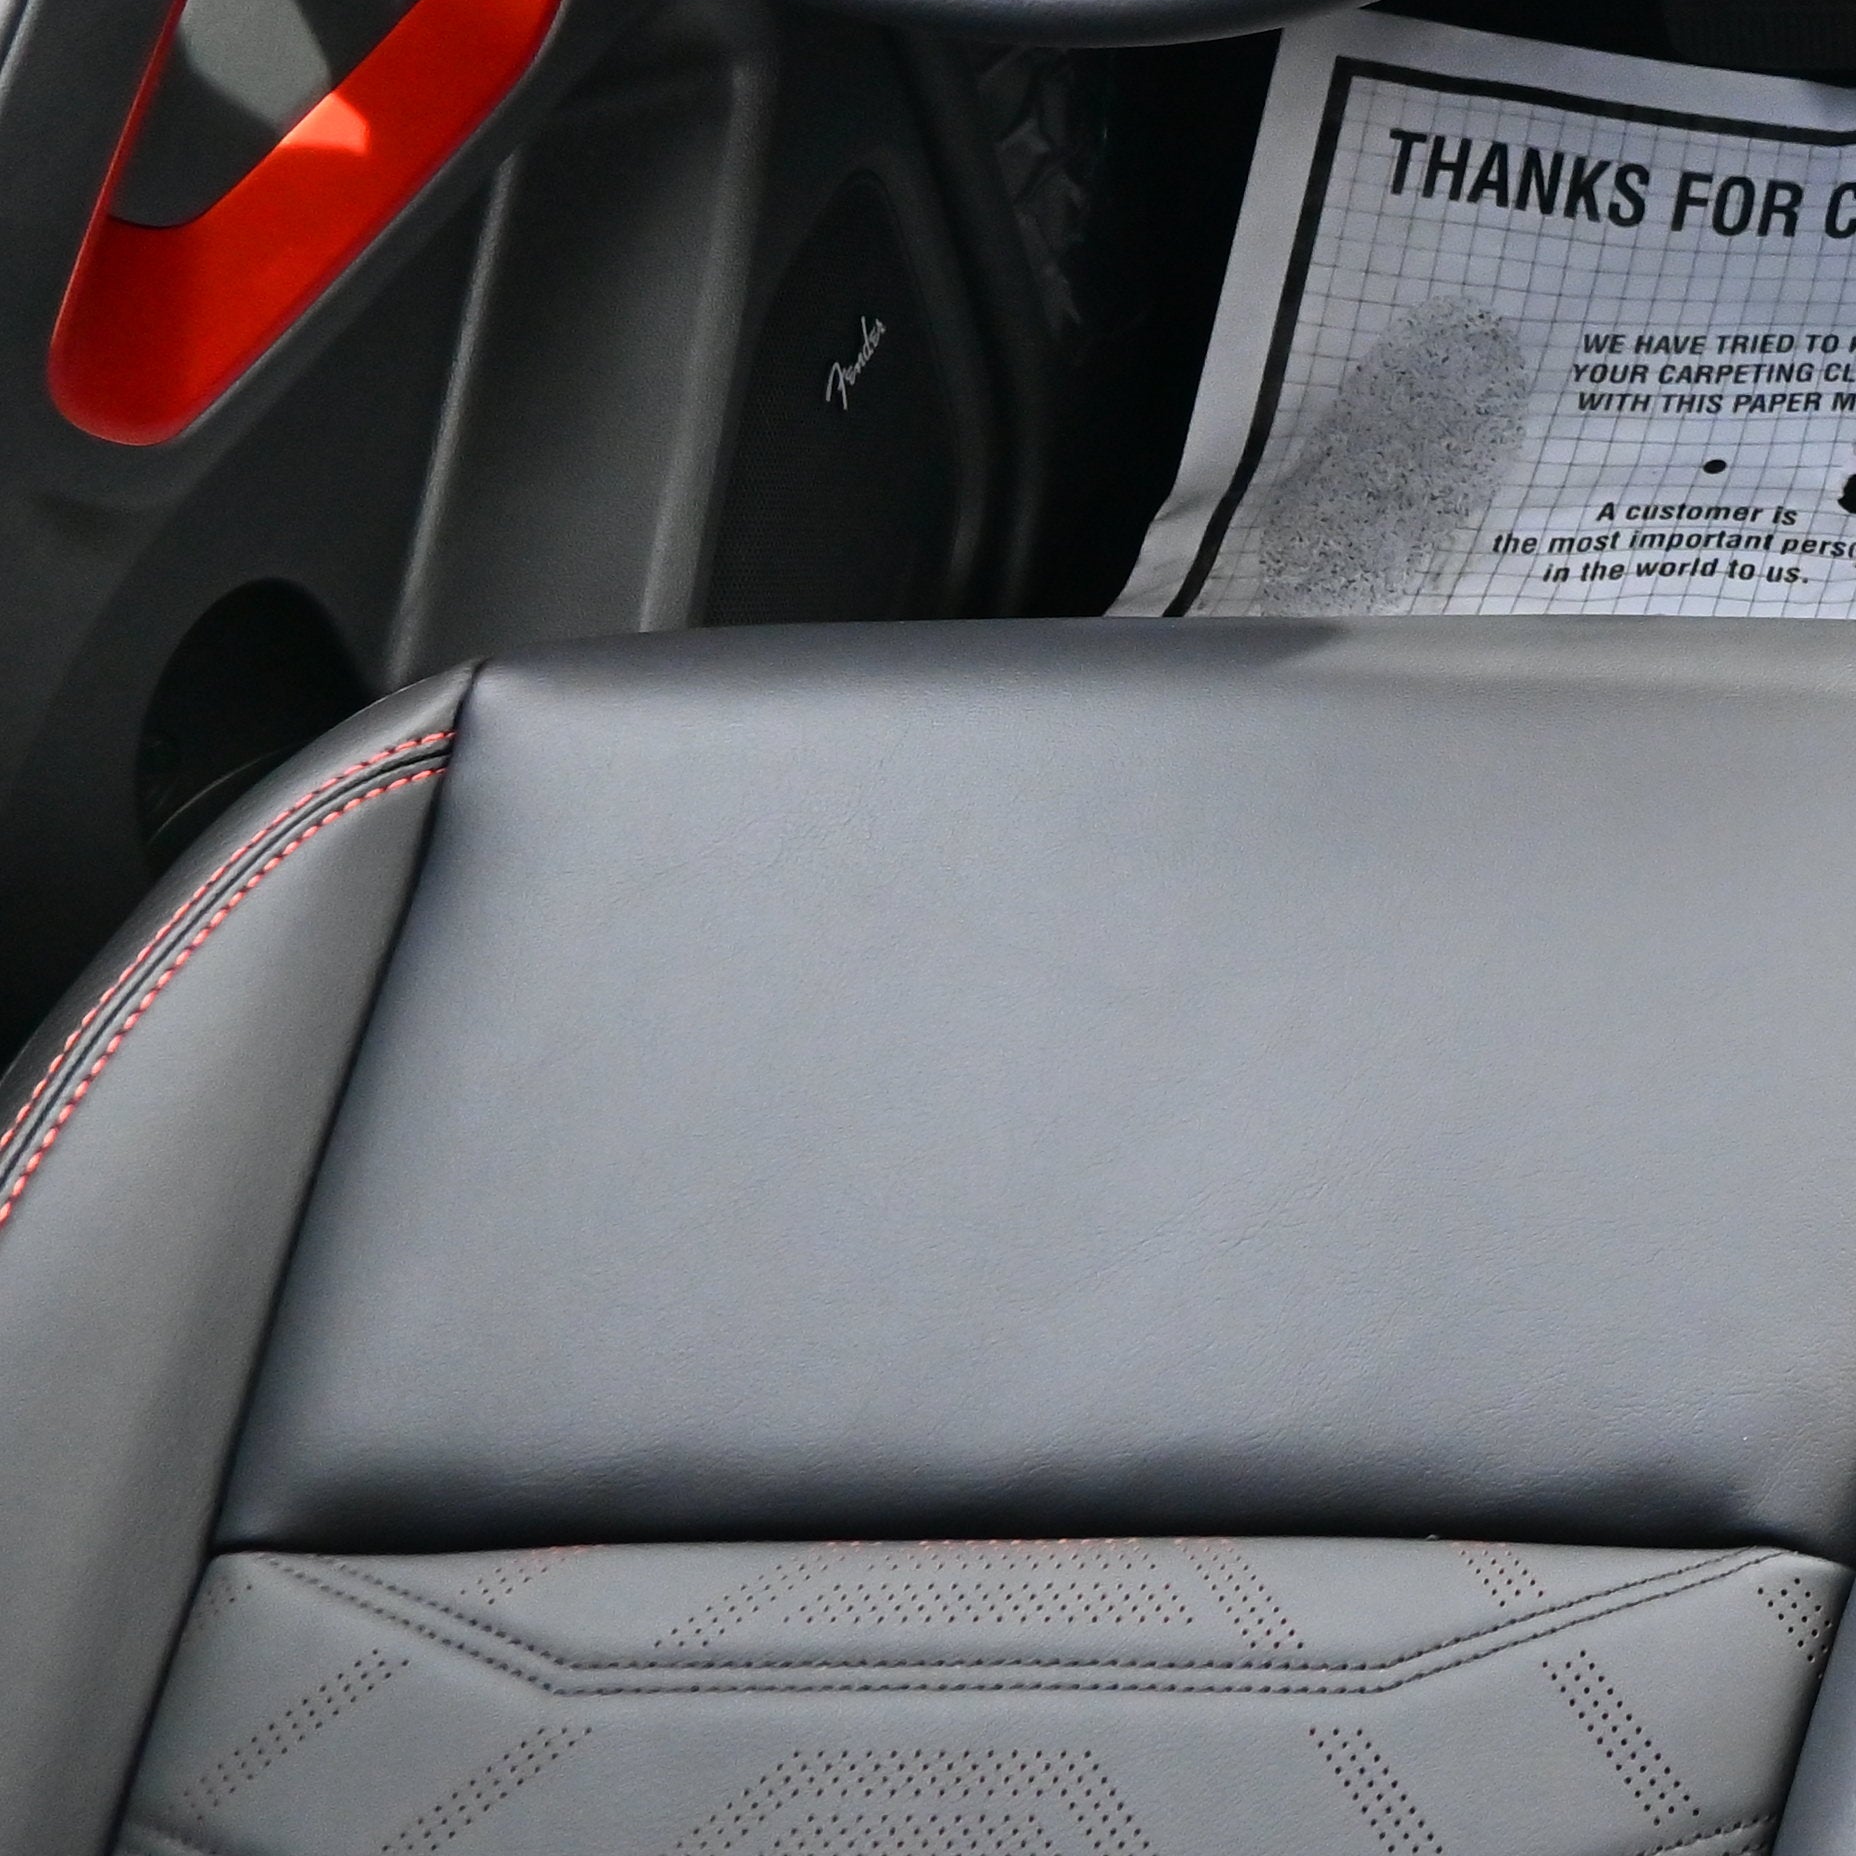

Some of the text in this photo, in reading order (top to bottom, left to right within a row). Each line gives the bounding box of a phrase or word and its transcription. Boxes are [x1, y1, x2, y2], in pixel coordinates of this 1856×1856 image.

[1388, 129, 1651, 231] THANKS
[1671, 171, 1802, 238] FOR
[1583, 333, 1622, 355] WE
[1633, 334, 1707, 355] HAVE
[1715, 334, 1795, 355] TRIED
[1805, 334, 1840, 355] TO
[1573, 363, 1648, 385] YOUR
[1658, 363, 1814, 385] CARPETING
[1577, 391, 1650, 414] WITH
[1661, 392, 1723, 414] THIS
[1732, 391, 1820, 414] PAPER
[1597, 502, 1798, 526] A customer is
[1492, 529, 1774, 555] the most important
[1543, 557, 1810, 584] in the world to us.
